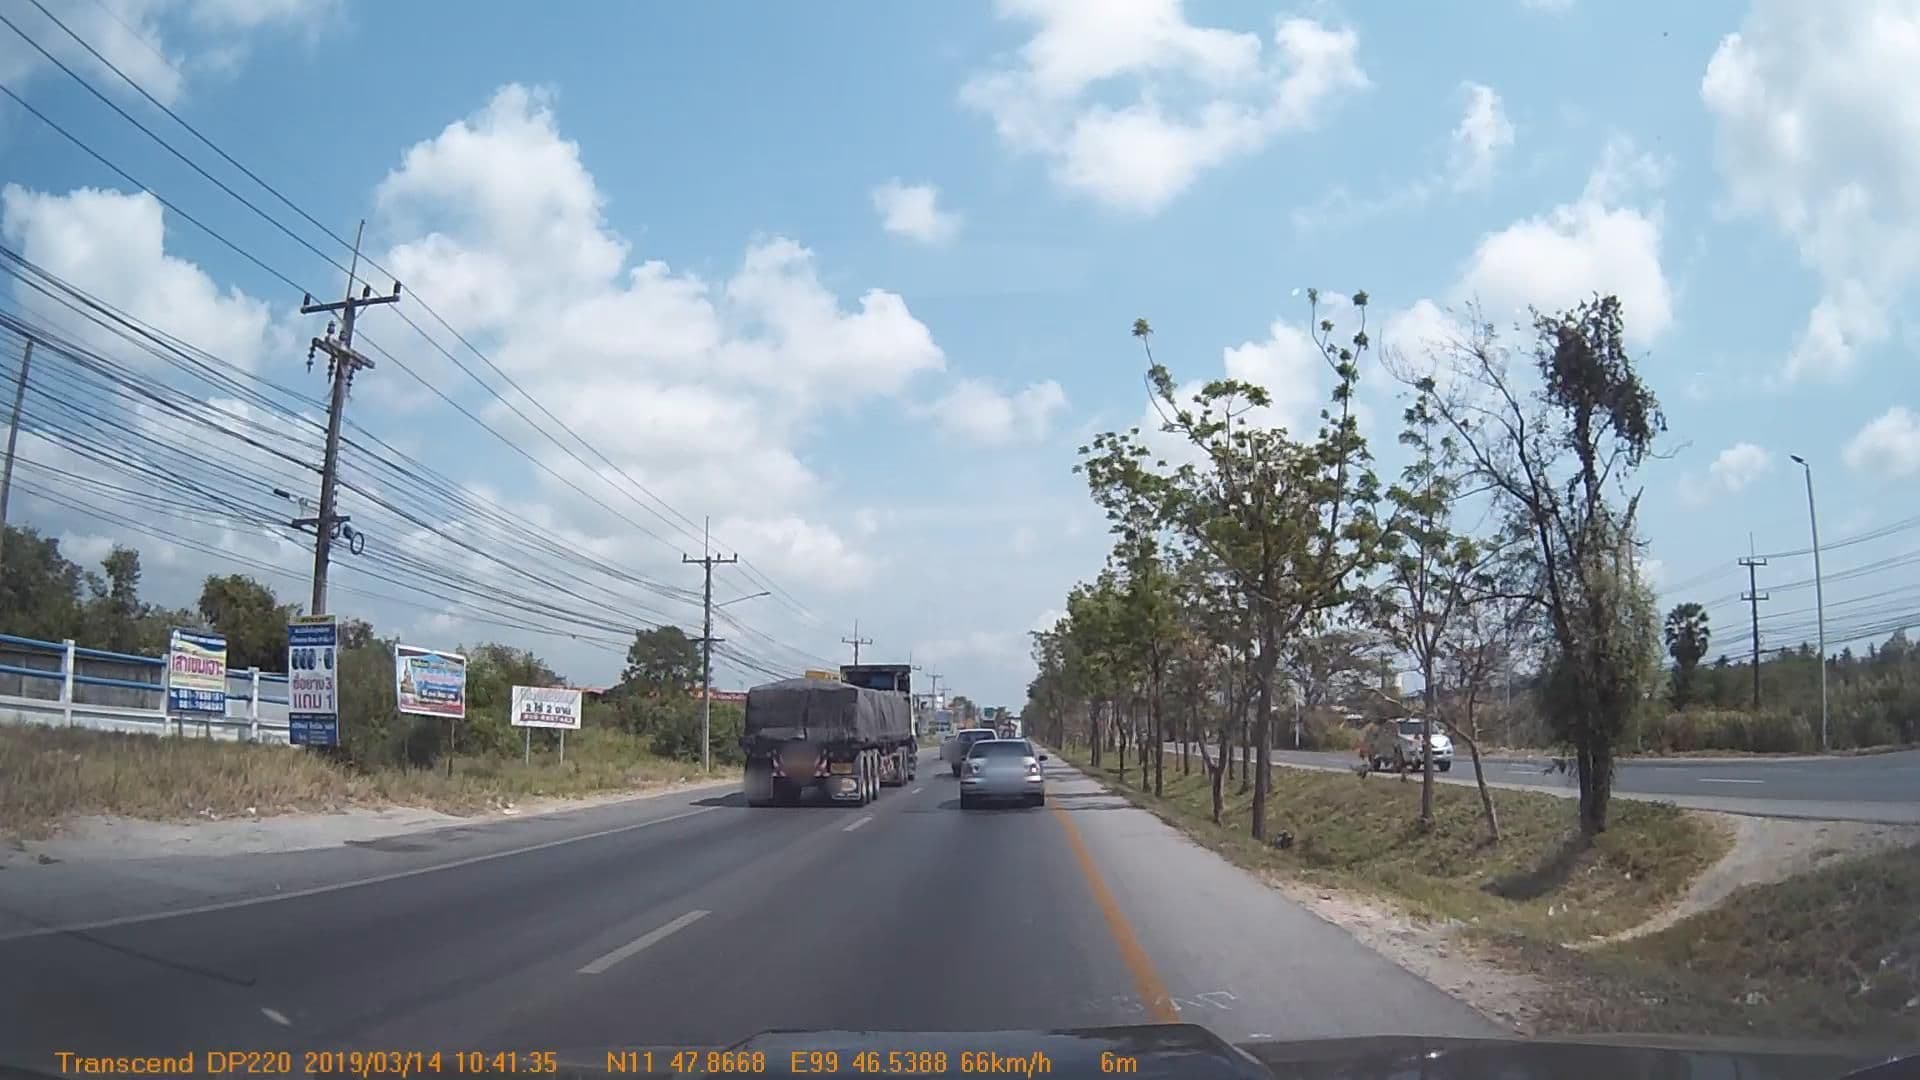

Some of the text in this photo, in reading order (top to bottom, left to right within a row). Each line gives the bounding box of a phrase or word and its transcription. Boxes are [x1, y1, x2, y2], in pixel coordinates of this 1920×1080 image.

[325, 676, 333, 690] 3
[326, 694, 333, 710] 1
[546, 704, 553, 714] 2
